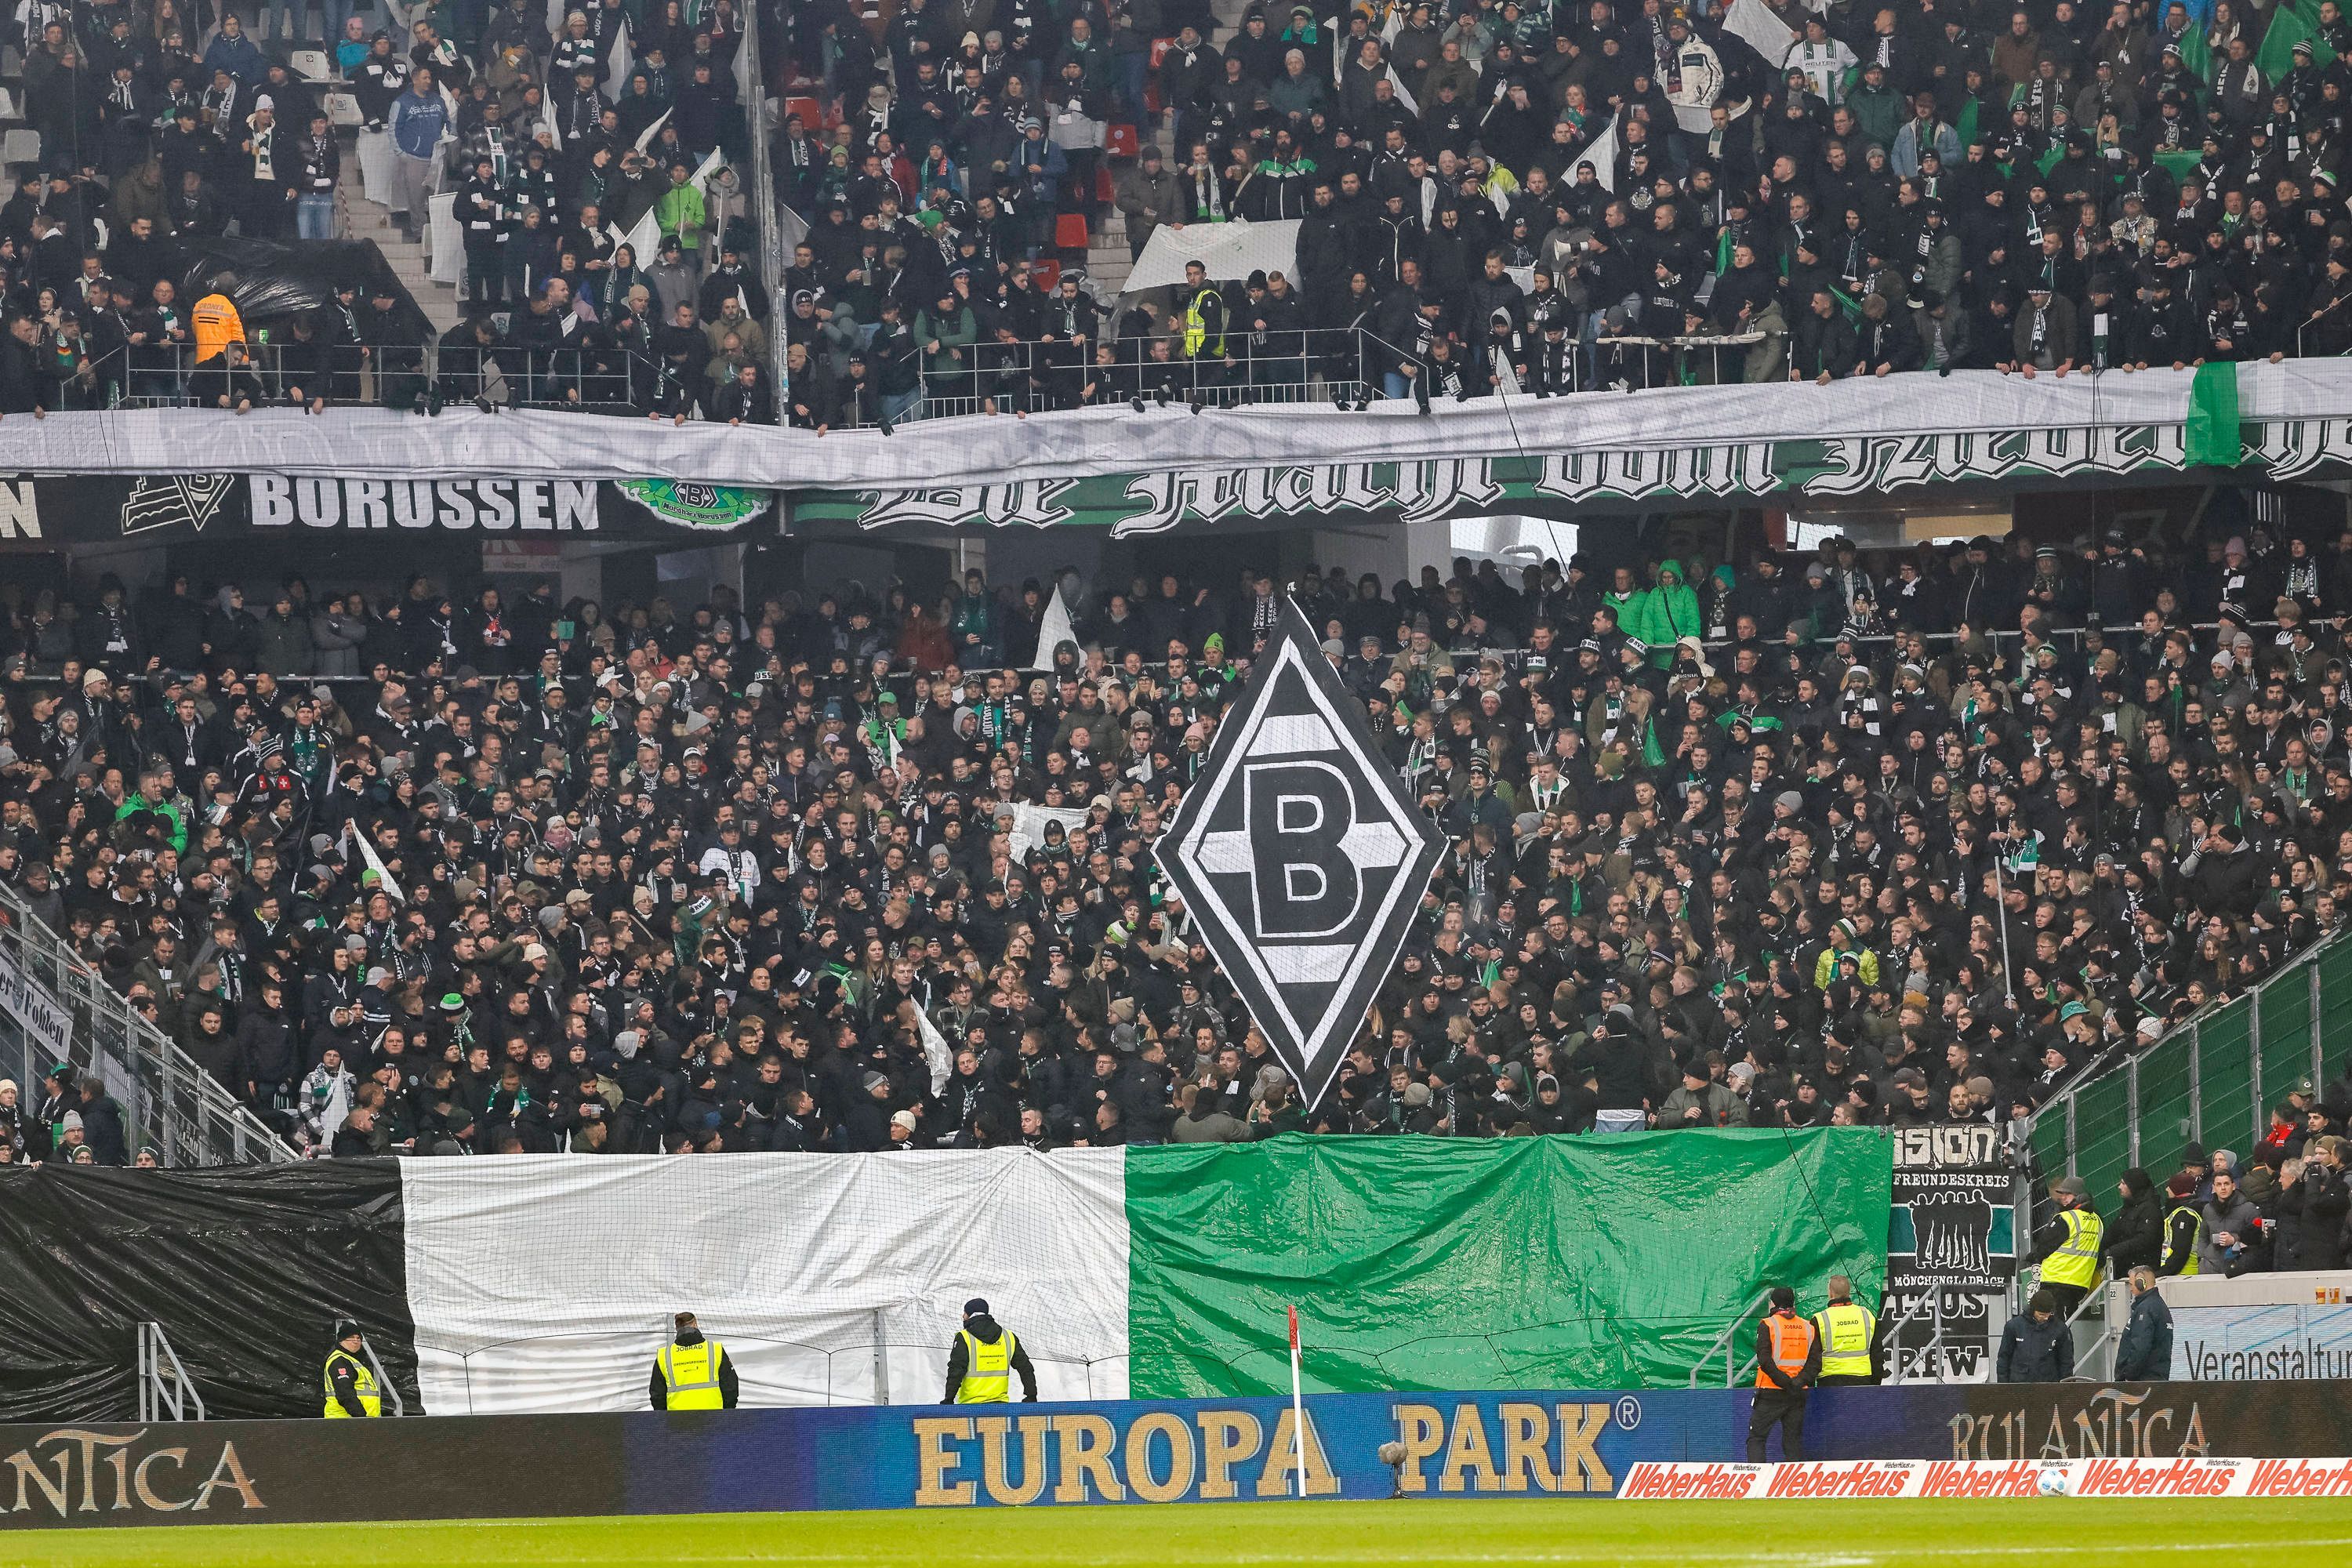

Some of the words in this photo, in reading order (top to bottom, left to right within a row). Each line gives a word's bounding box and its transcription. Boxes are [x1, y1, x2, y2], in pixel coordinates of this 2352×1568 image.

[249, 474, 599, 530] BORUSSEN
[1243, 760, 1363, 938] B
[1893, 1174, 2009, 1187] FREUNDESKREIS
[1894, 1274, 2005, 1287] MÖNCHENGLADBACH
[0, 1428, 268, 1519] NTICA
[913, 1406, 1341, 1507] EUROPA
[1625, 1464, 1757, 1498] WeberHaus
[1766, 1461, 1911, 1497] WeberHaus
[1921, 1460, 2068, 1497] WeberHa
[2078, 1459, 2235, 1496] WeberHaus
